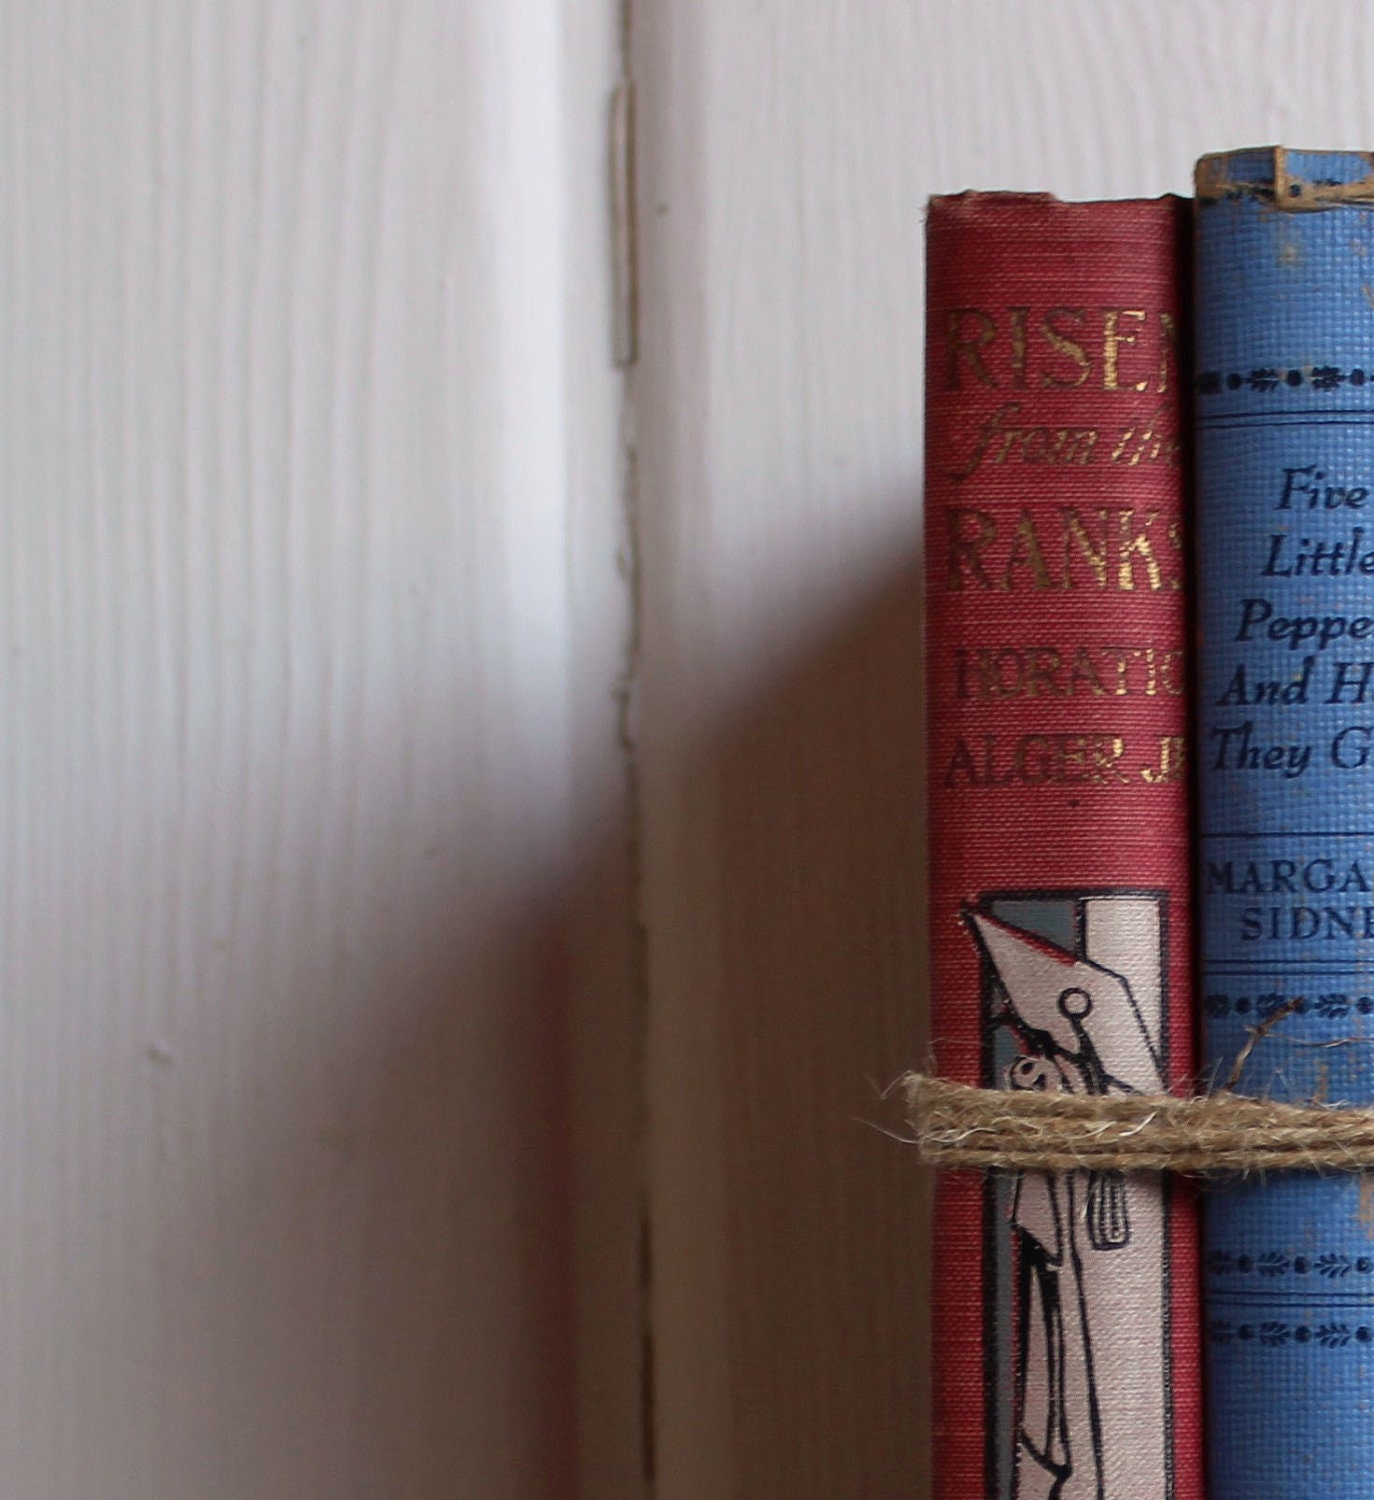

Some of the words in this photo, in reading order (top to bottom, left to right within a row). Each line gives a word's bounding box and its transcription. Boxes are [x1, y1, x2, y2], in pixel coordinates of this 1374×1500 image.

[950, 402, 1098, 482] from
[1275, 464, 1369, 510] Five
[1215, 656, 1315, 706] And
[946, 734, 1130, 788] ALGER
[1212, 721, 1312, 778] They
